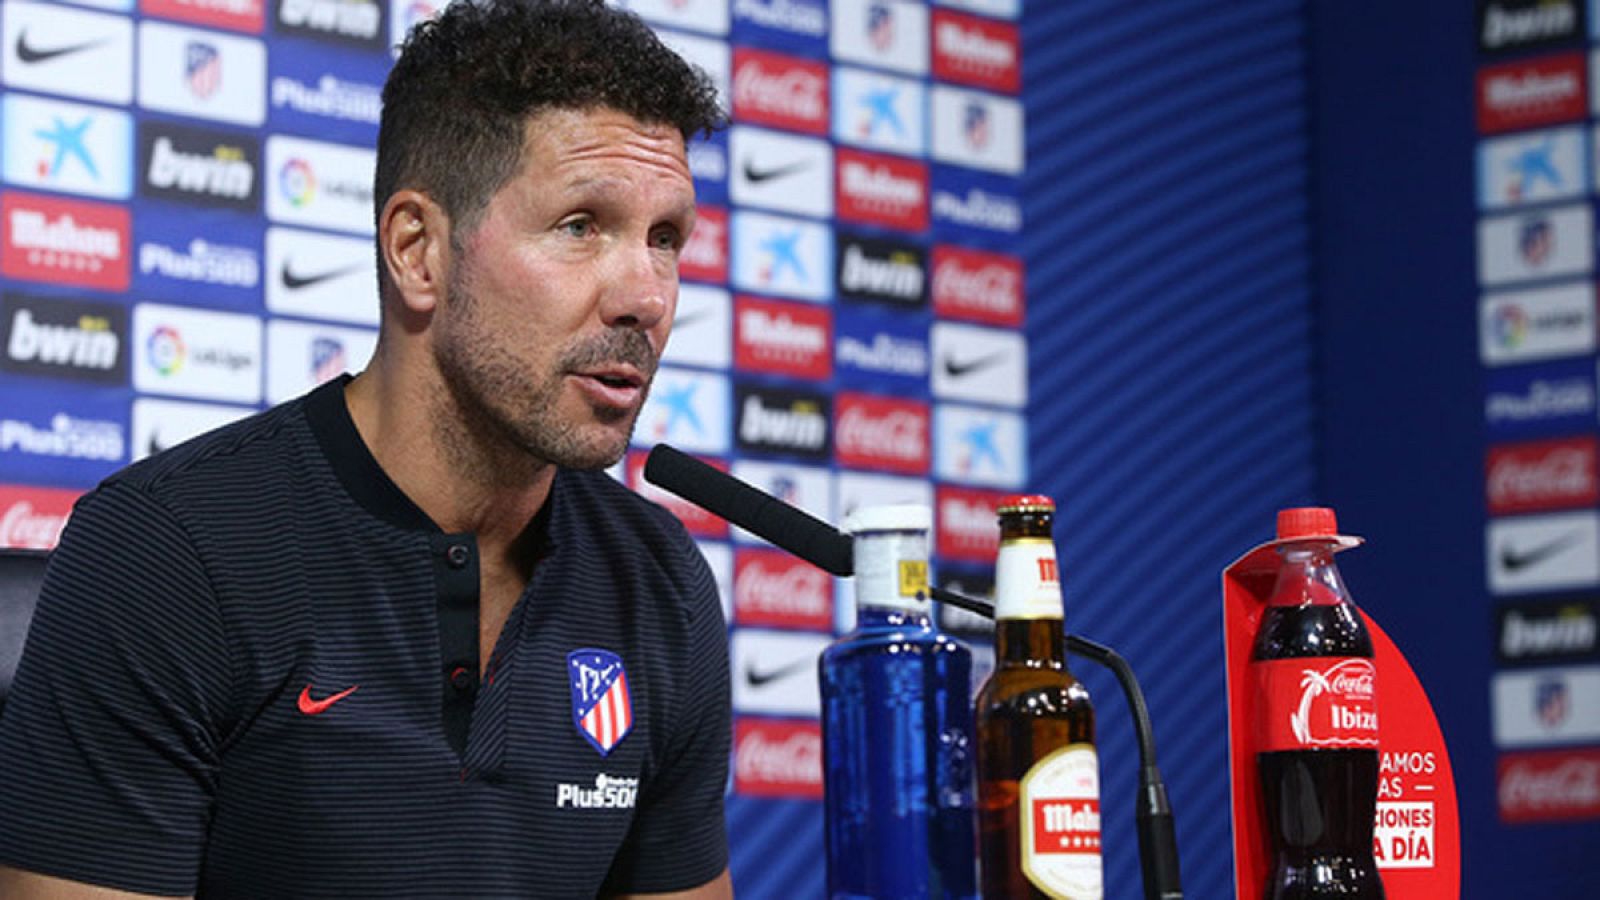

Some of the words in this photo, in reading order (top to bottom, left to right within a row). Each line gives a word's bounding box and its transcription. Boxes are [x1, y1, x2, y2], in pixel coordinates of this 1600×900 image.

[149, 136, 253, 200] bwin
[841, 245, 924, 299] bwin
[8, 309, 119, 370] bwin
[739, 396, 826, 448] bwin
[1376, 777, 1403, 798] AS
[1379, 751, 1435, 773] AMOS
[1391, 830, 1431, 861] DÍA
